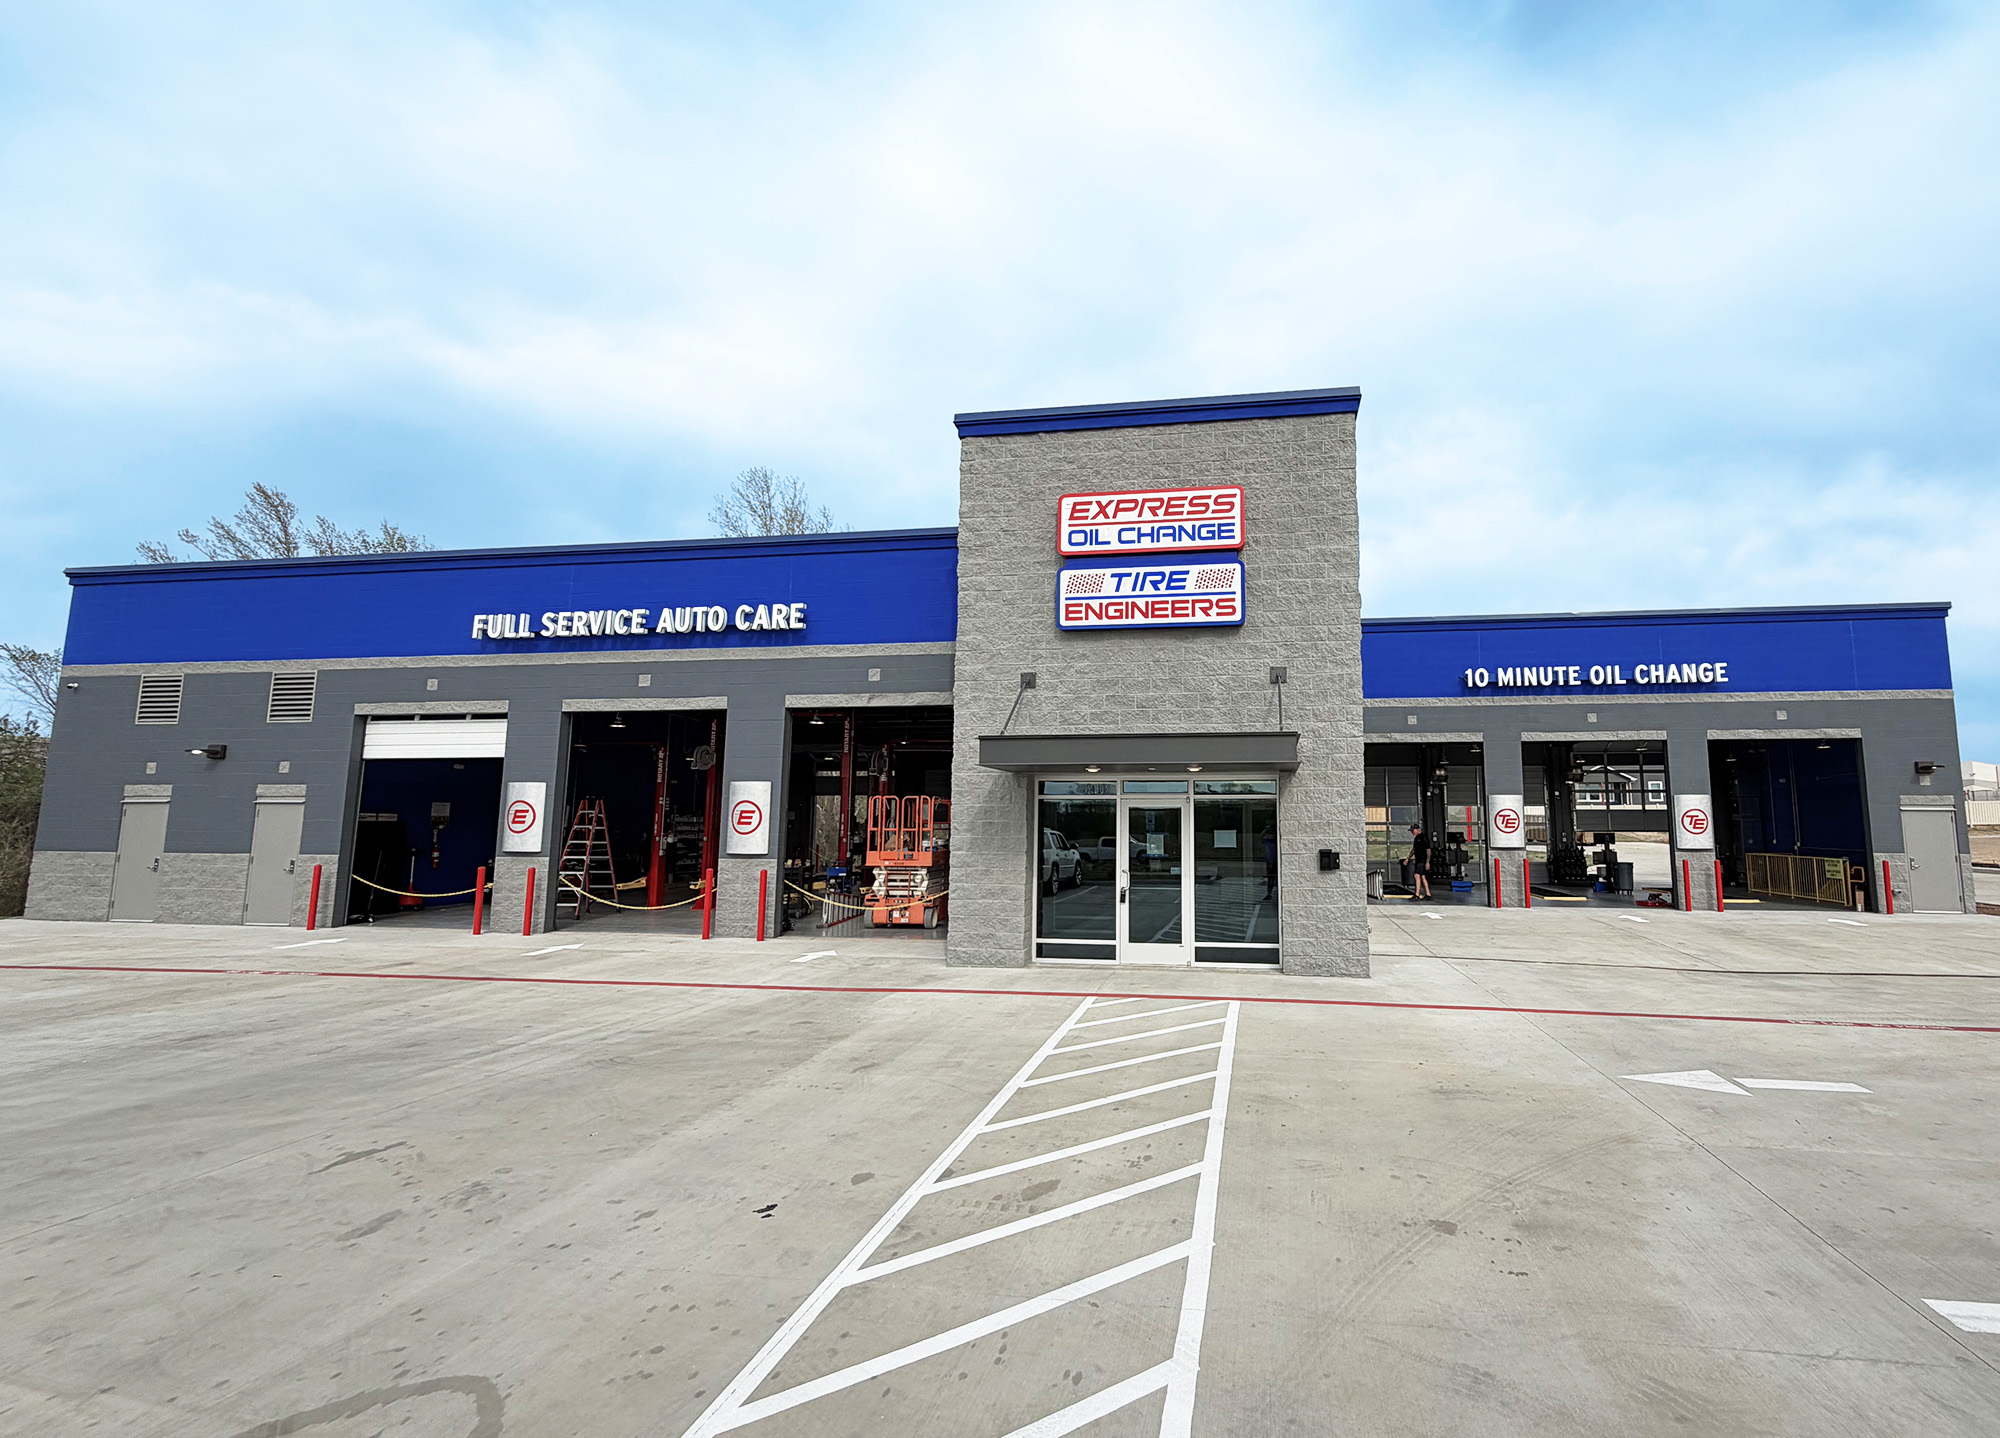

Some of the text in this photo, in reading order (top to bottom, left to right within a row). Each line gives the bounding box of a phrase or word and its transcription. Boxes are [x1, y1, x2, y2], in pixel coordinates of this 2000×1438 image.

[1068, 493, 1238, 521] EXPRESS
[1067, 522, 1236, 547] OIL CHANGE
[1110, 570, 1190, 593] TIRE
[1065, 597, 1237, 621] ENGINEERS
[472, 602, 807, 640] FULL SERVICE AUTO CARE
[1464, 662, 1729, 688] 10 MINUTE OIL CHANGE
[511, 809, 530, 825] E
[736, 809, 756, 826] E
[1498, 814, 1518, 829] TE
[1685, 814, 1706, 830] TE
